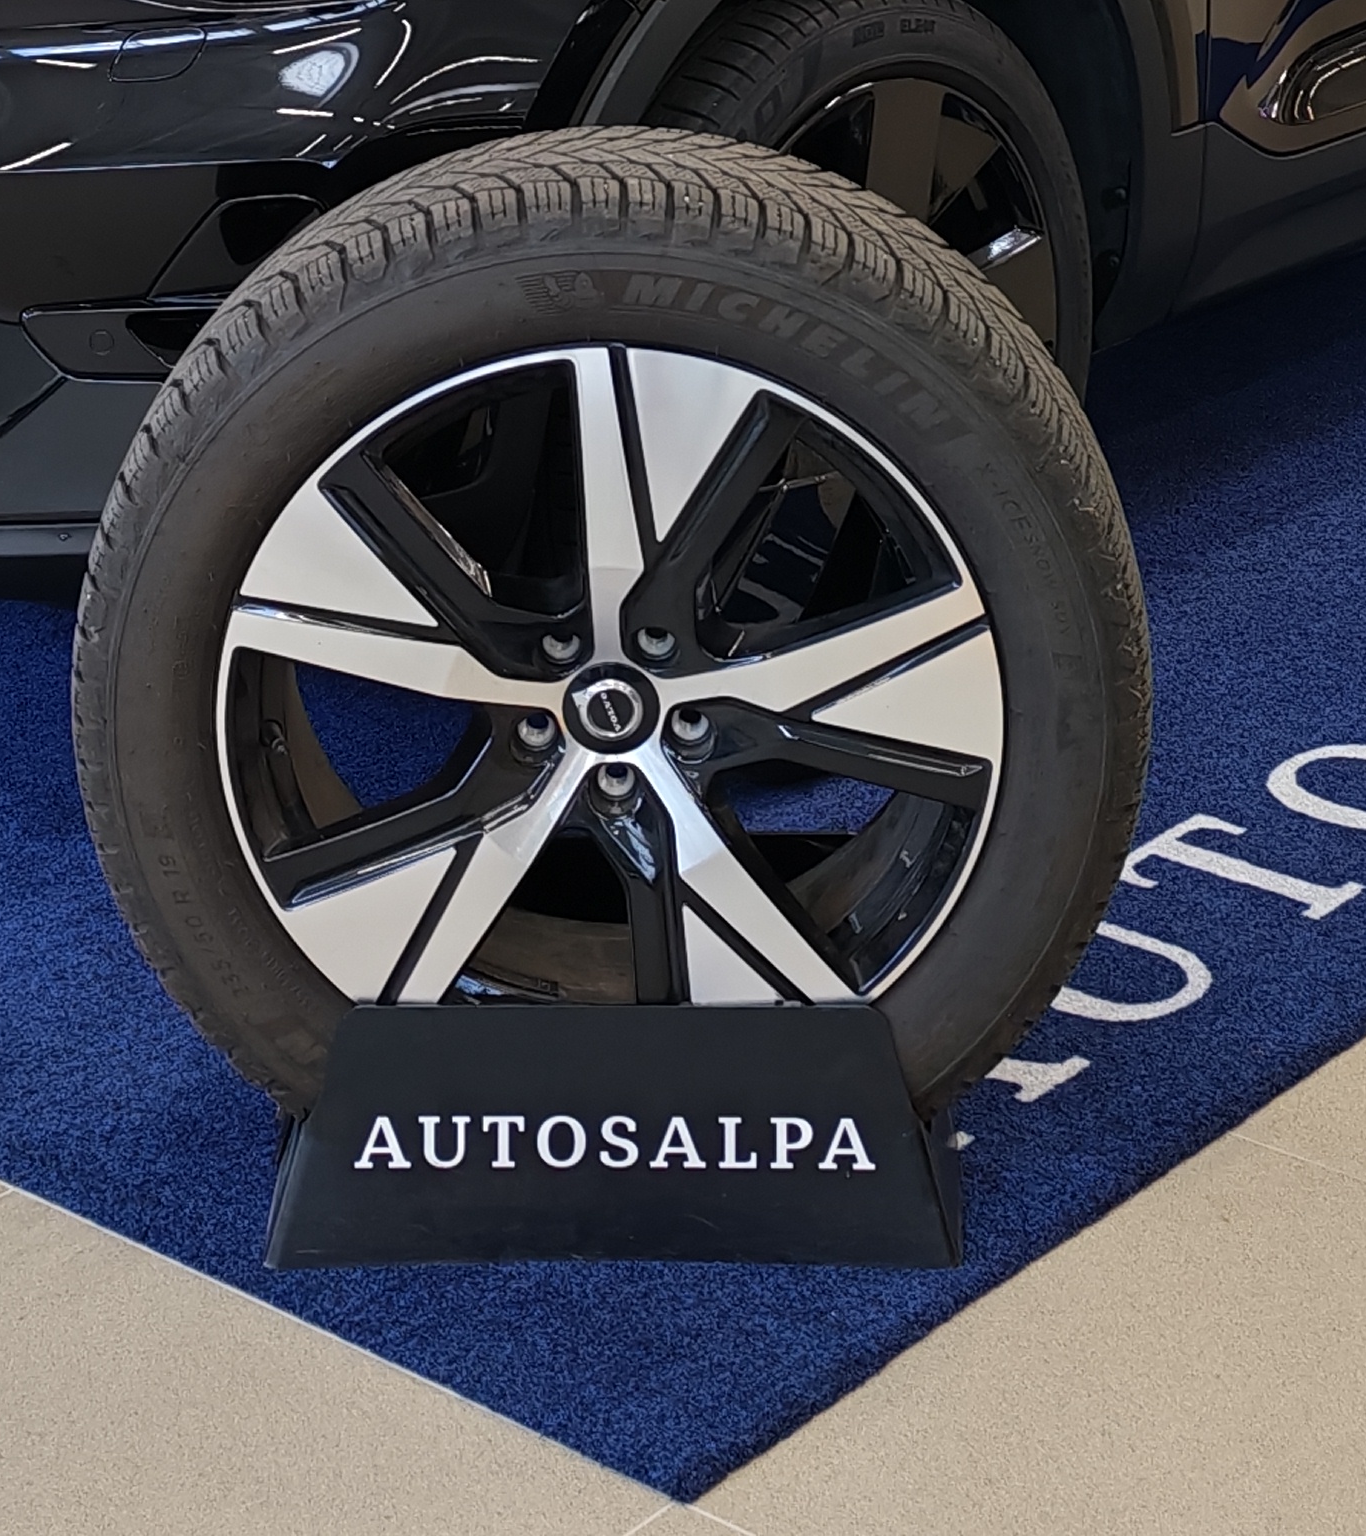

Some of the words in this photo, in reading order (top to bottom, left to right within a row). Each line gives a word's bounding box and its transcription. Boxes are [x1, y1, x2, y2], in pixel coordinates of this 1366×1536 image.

[621, 272, 953, 431] MICHELIN
[600, 691, 622, 733] VOLVO
[353, 1114, 877, 1171] AUTOSALPA
